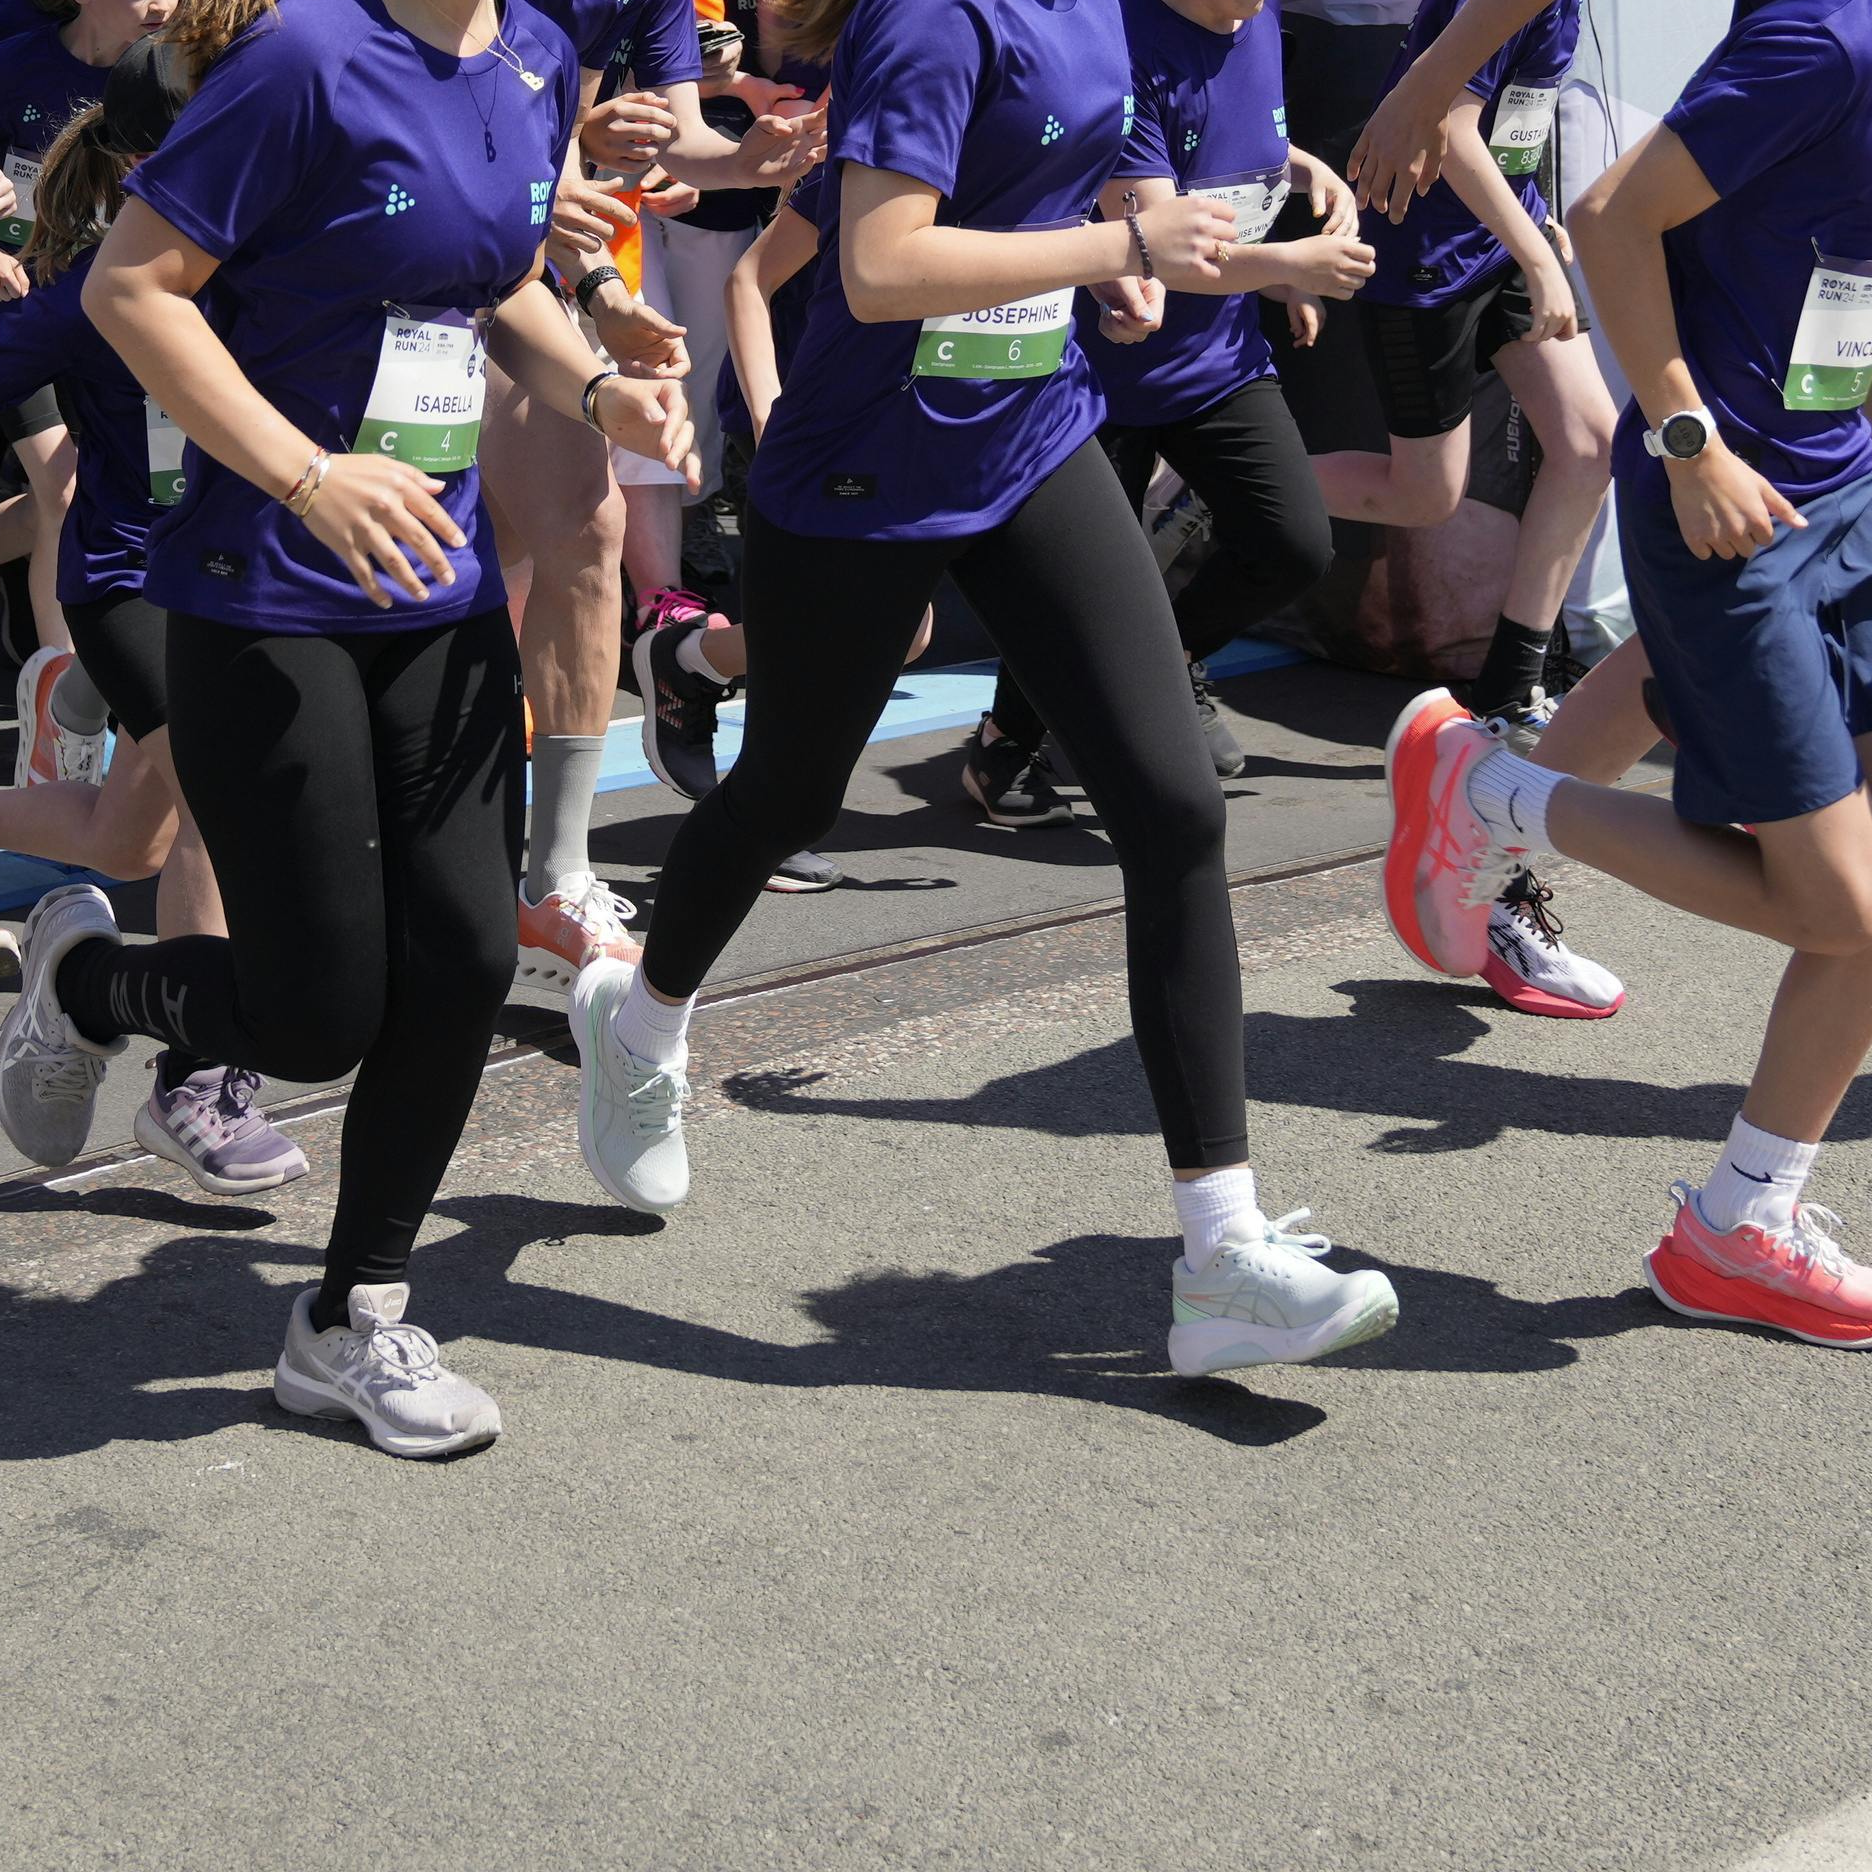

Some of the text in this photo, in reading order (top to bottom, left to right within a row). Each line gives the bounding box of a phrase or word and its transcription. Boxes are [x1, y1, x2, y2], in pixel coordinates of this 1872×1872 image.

[1509, 90, 1535, 100] ROYAL
[1497, 153, 1509, 165] C
[8, 223, 21, 236] C
[1820, 277, 1857, 292] ROYAL
[962, 302, 1059, 324] JOSEPHINE
[396, 328, 432, 341] ROYAL
[938, 339, 1022, 361] C 6
[1801, 371, 1864, 394] C 5
[414, 394, 473, 414] ISABELLA
[380, 430, 451, 453] C 4
